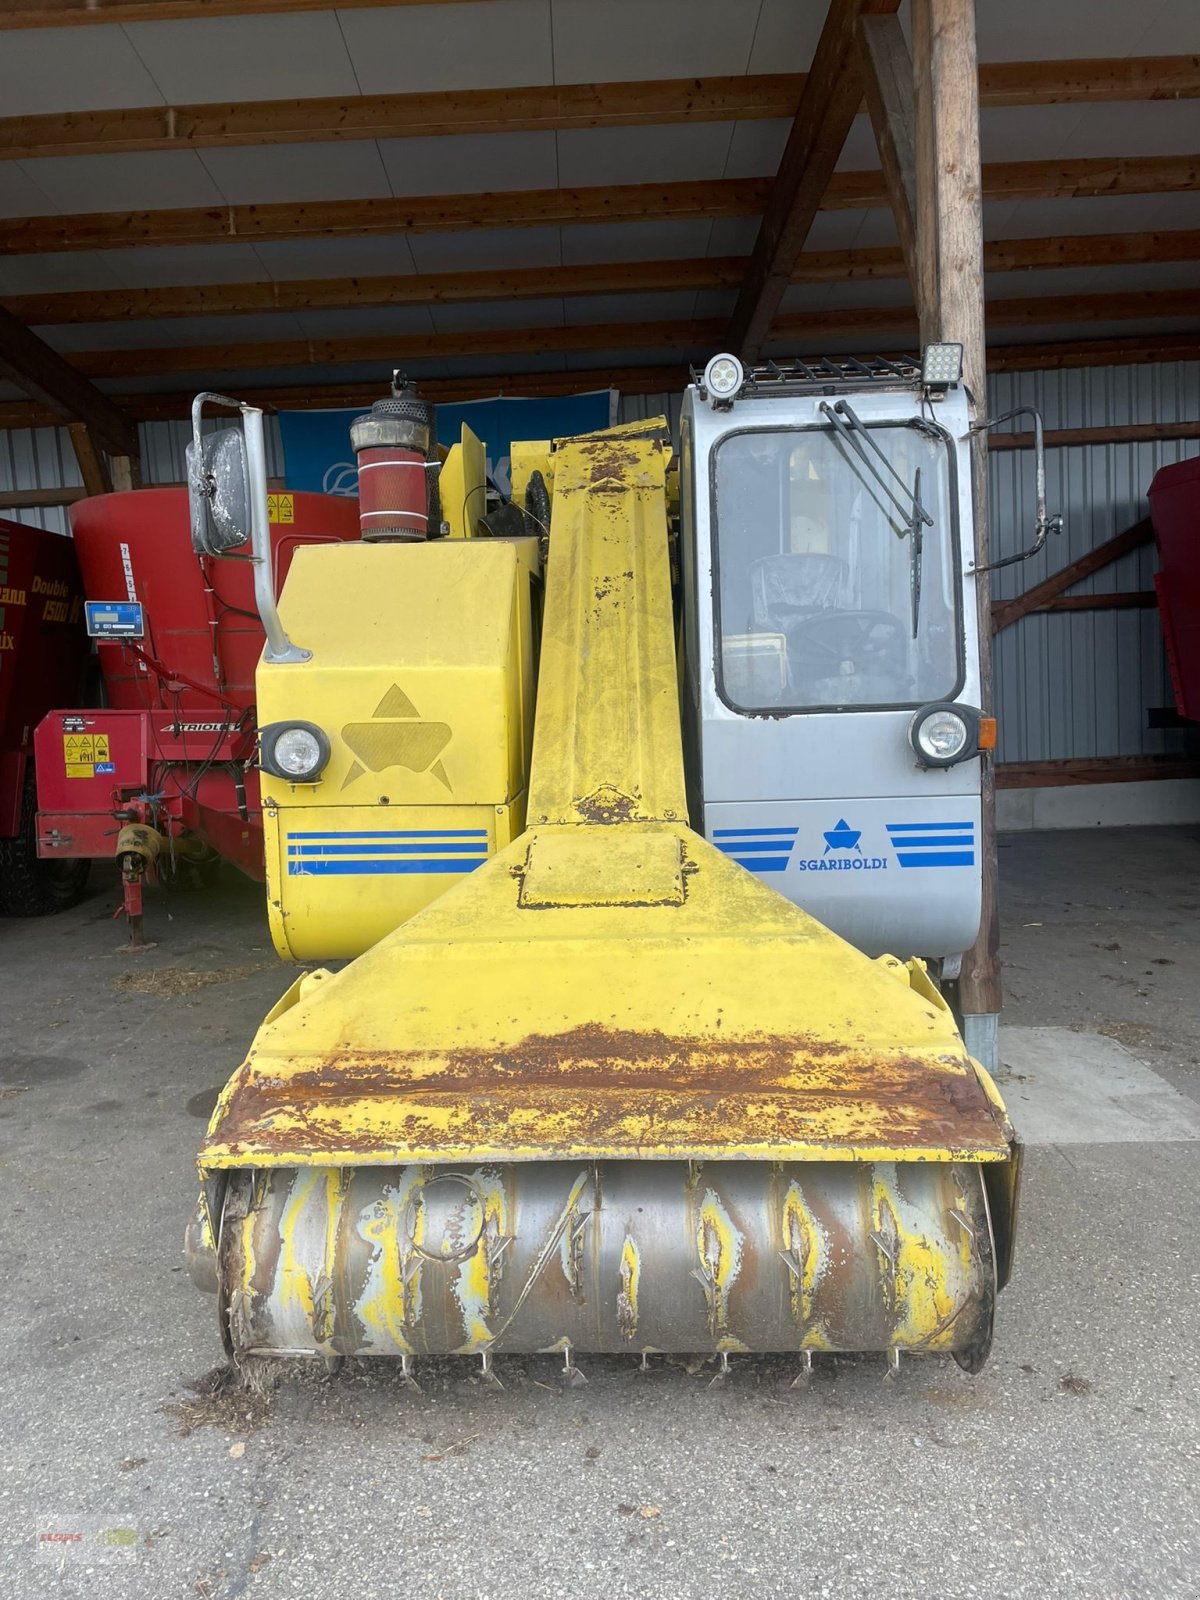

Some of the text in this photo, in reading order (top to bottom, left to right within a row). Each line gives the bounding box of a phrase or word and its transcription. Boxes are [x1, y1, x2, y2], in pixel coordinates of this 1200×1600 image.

[0, 586, 27, 605] ann
[31, 575, 70, 597] Double
[799, 858, 888, 871] SGARIBOLDI
